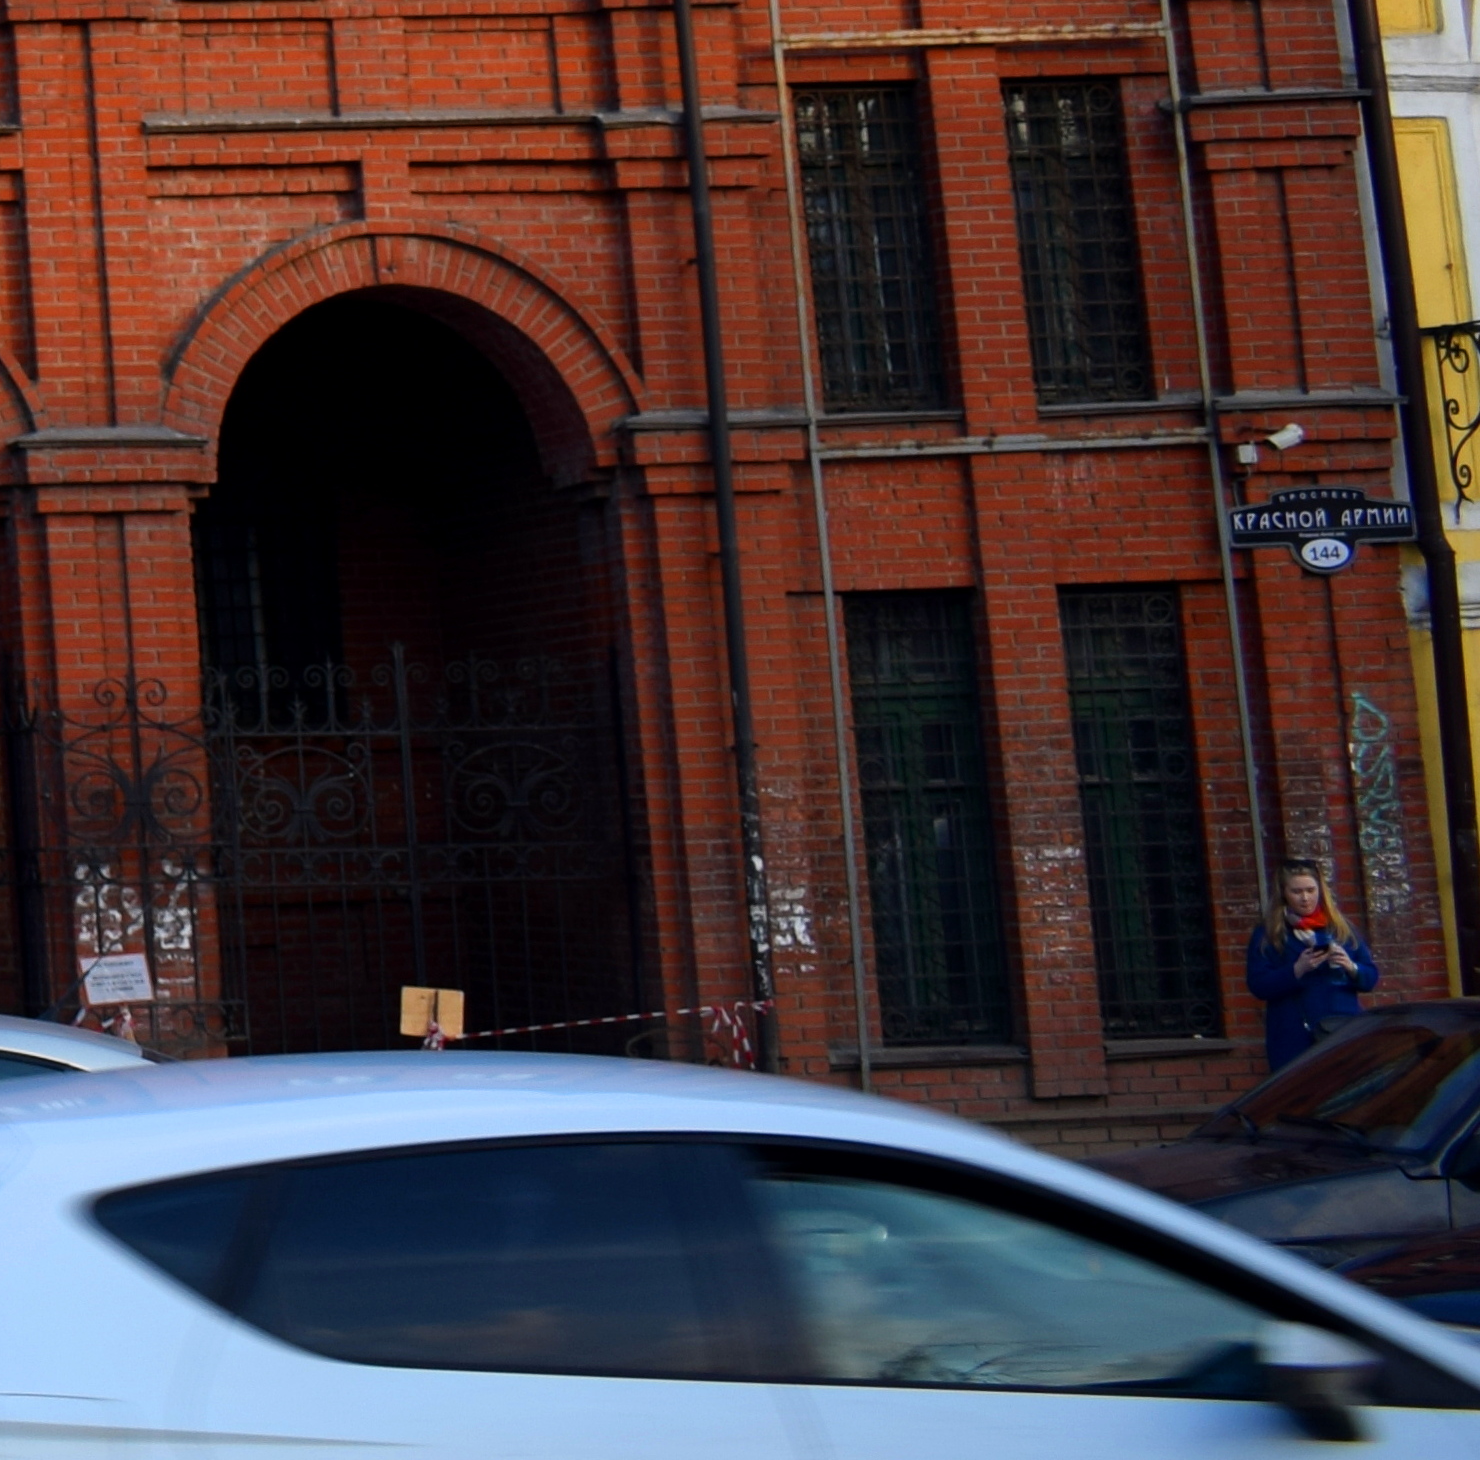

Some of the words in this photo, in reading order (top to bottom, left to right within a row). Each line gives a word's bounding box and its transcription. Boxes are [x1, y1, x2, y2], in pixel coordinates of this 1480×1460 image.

[1278, 490, 1359, 504] ПРОСПЕКТ
[1232, 507, 1327, 531] КРАСНОЙ
[1340, 506, 1409, 527] АРМИИ
[1309, 545, 1341, 562] 144
